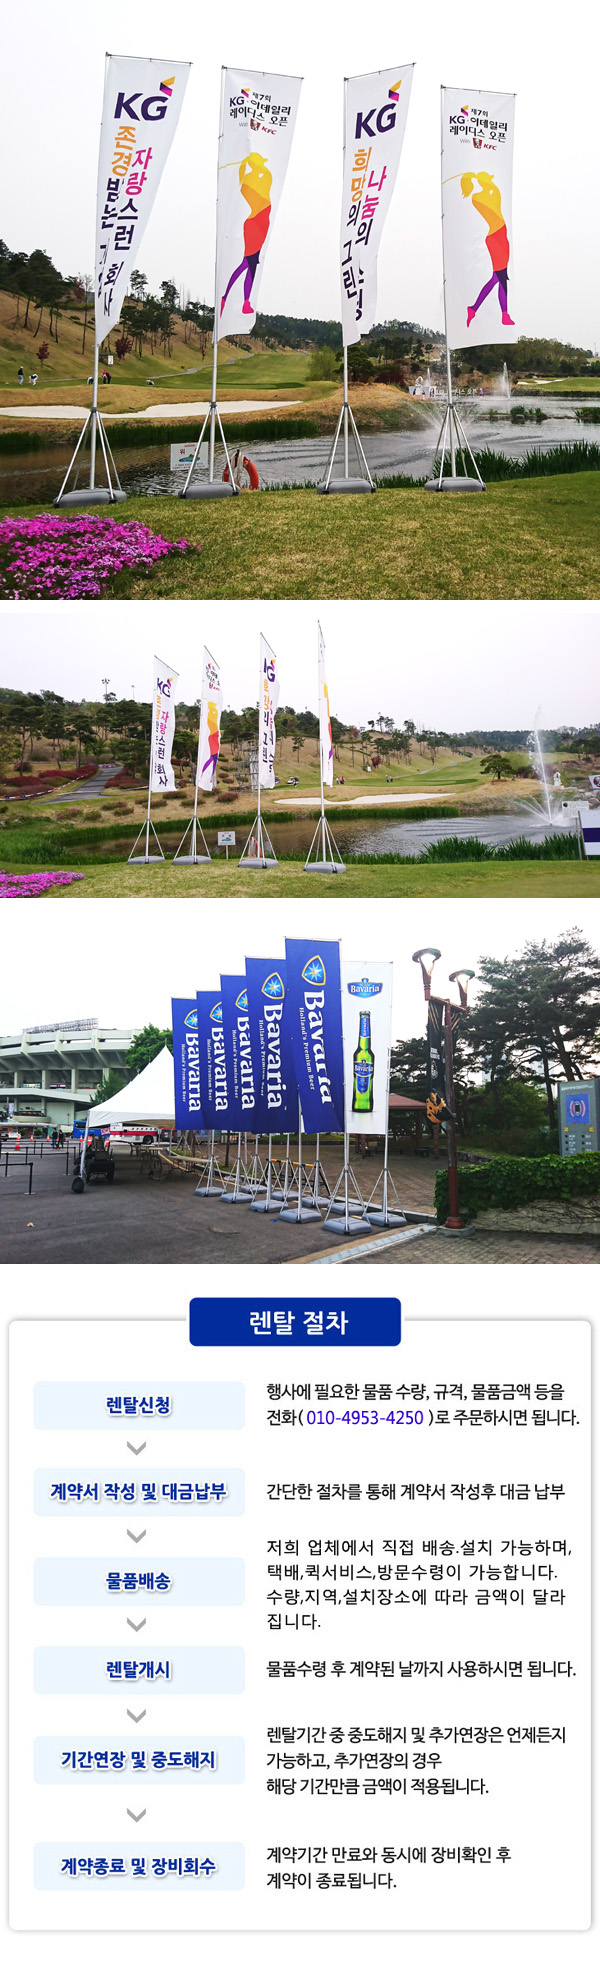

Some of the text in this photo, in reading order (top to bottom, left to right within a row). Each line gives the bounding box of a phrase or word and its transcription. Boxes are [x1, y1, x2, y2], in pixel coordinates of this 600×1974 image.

[114, 92, 169, 121] KG
[230, 106, 288, 127] 레이디스 오픈
[262, 126, 277, 135] KFC
[355, 102, 397, 139] KG
[449, 125, 506, 143] 레이디스 오픈
[483, 143, 497, 151] KFC
[350, 984, 381, 994] Bavaria
[263, 1002, 287, 1109] Bavaria
[303, 989, 332, 1104] Bavaria
[303, 1042, 313, 1073] Premium
